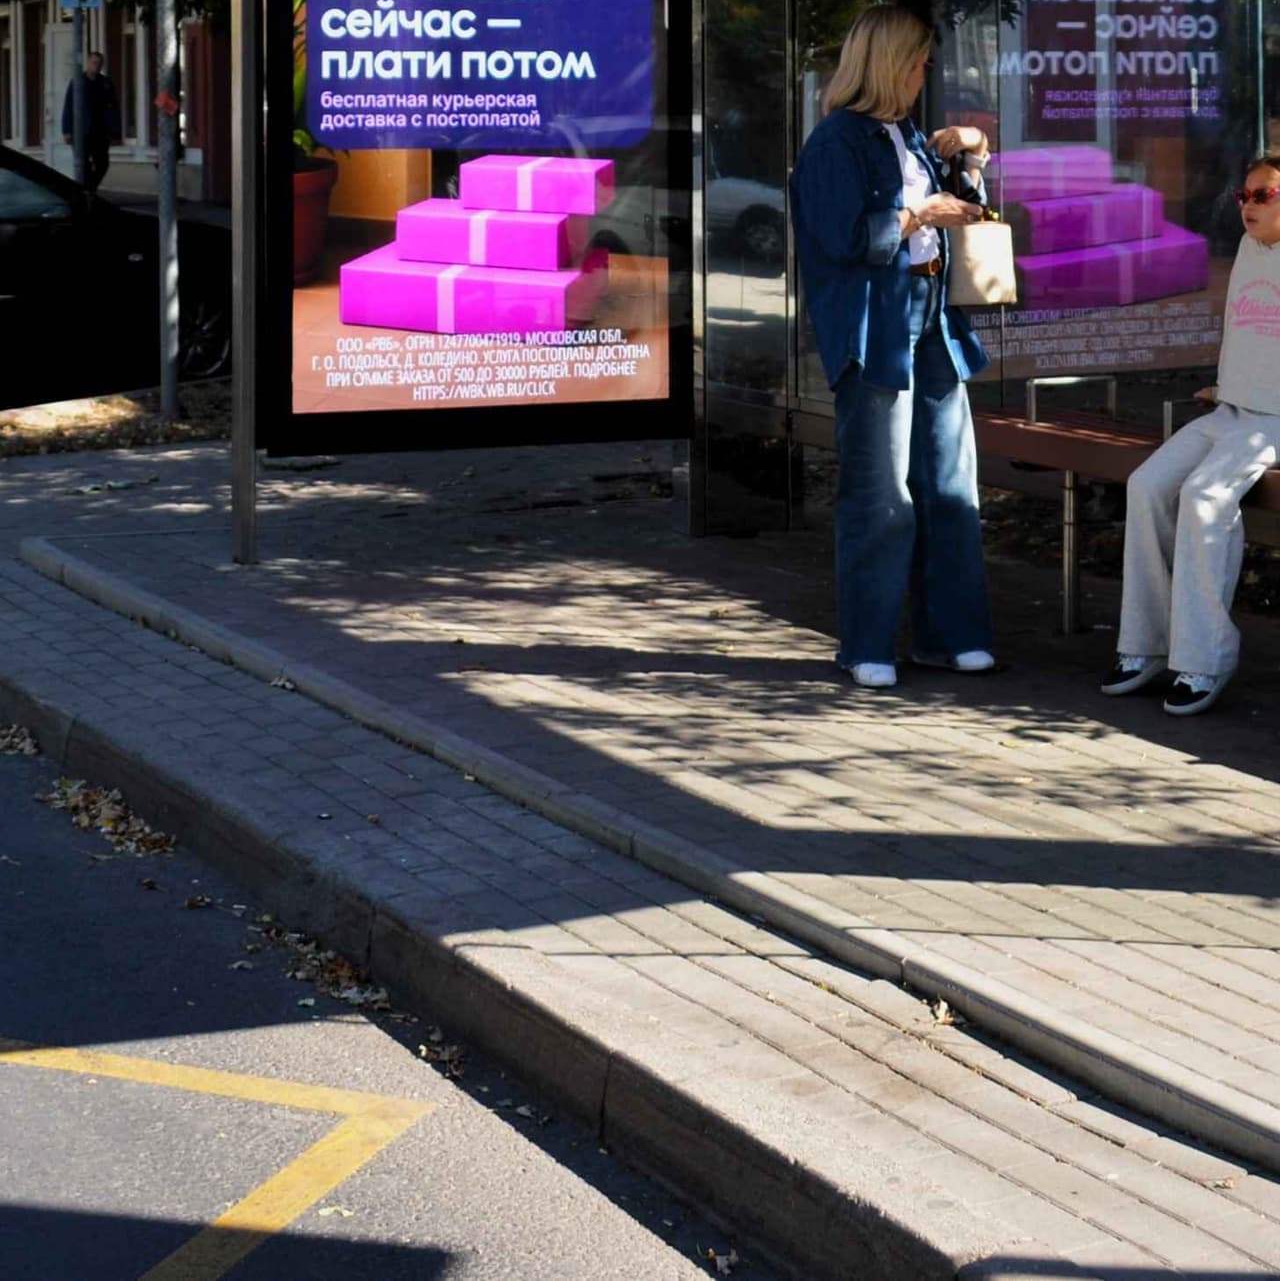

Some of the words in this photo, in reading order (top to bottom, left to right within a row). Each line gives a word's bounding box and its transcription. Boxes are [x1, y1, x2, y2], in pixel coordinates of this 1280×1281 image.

[320, 0, 476, 39] сейчас
[321, 50, 452, 79] плати
[461, 50, 596, 79] потом
[320, 91, 428, 109] бесплатная
[432, 93, 537, 112] курьерская
[320, 112, 407, 130] доставка
[411, 114, 421, 127] с
[426, 109, 540, 127] постоплатой
[336, 337, 363, 353] ООО
[405, 335, 434, 350] ОГРН
[525, 329, 598, 346] МОСКОВСКАЯ
[324, 355, 336, 370] О.
[483, 348, 521, 364] УСЛУГА
[522, 346, 595, 363] ПОСТОПЛАТЫ
[596, 344, 650, 362] ДОСТУПНА
[326, 372, 351, 387] ПРИ
[352, 371, 394, 387] СУММЕ
[395, 370, 436, 385] ЗАКАЗА
[437, 368, 452, 383] ОТ
[454, 368, 474, 383] 500
[476, 366, 492, 382] ДО
[529, 361, 571, 379] РУБЛЕЙ.
[573, 361, 637, 379] ПОДРОБНЕЕ
